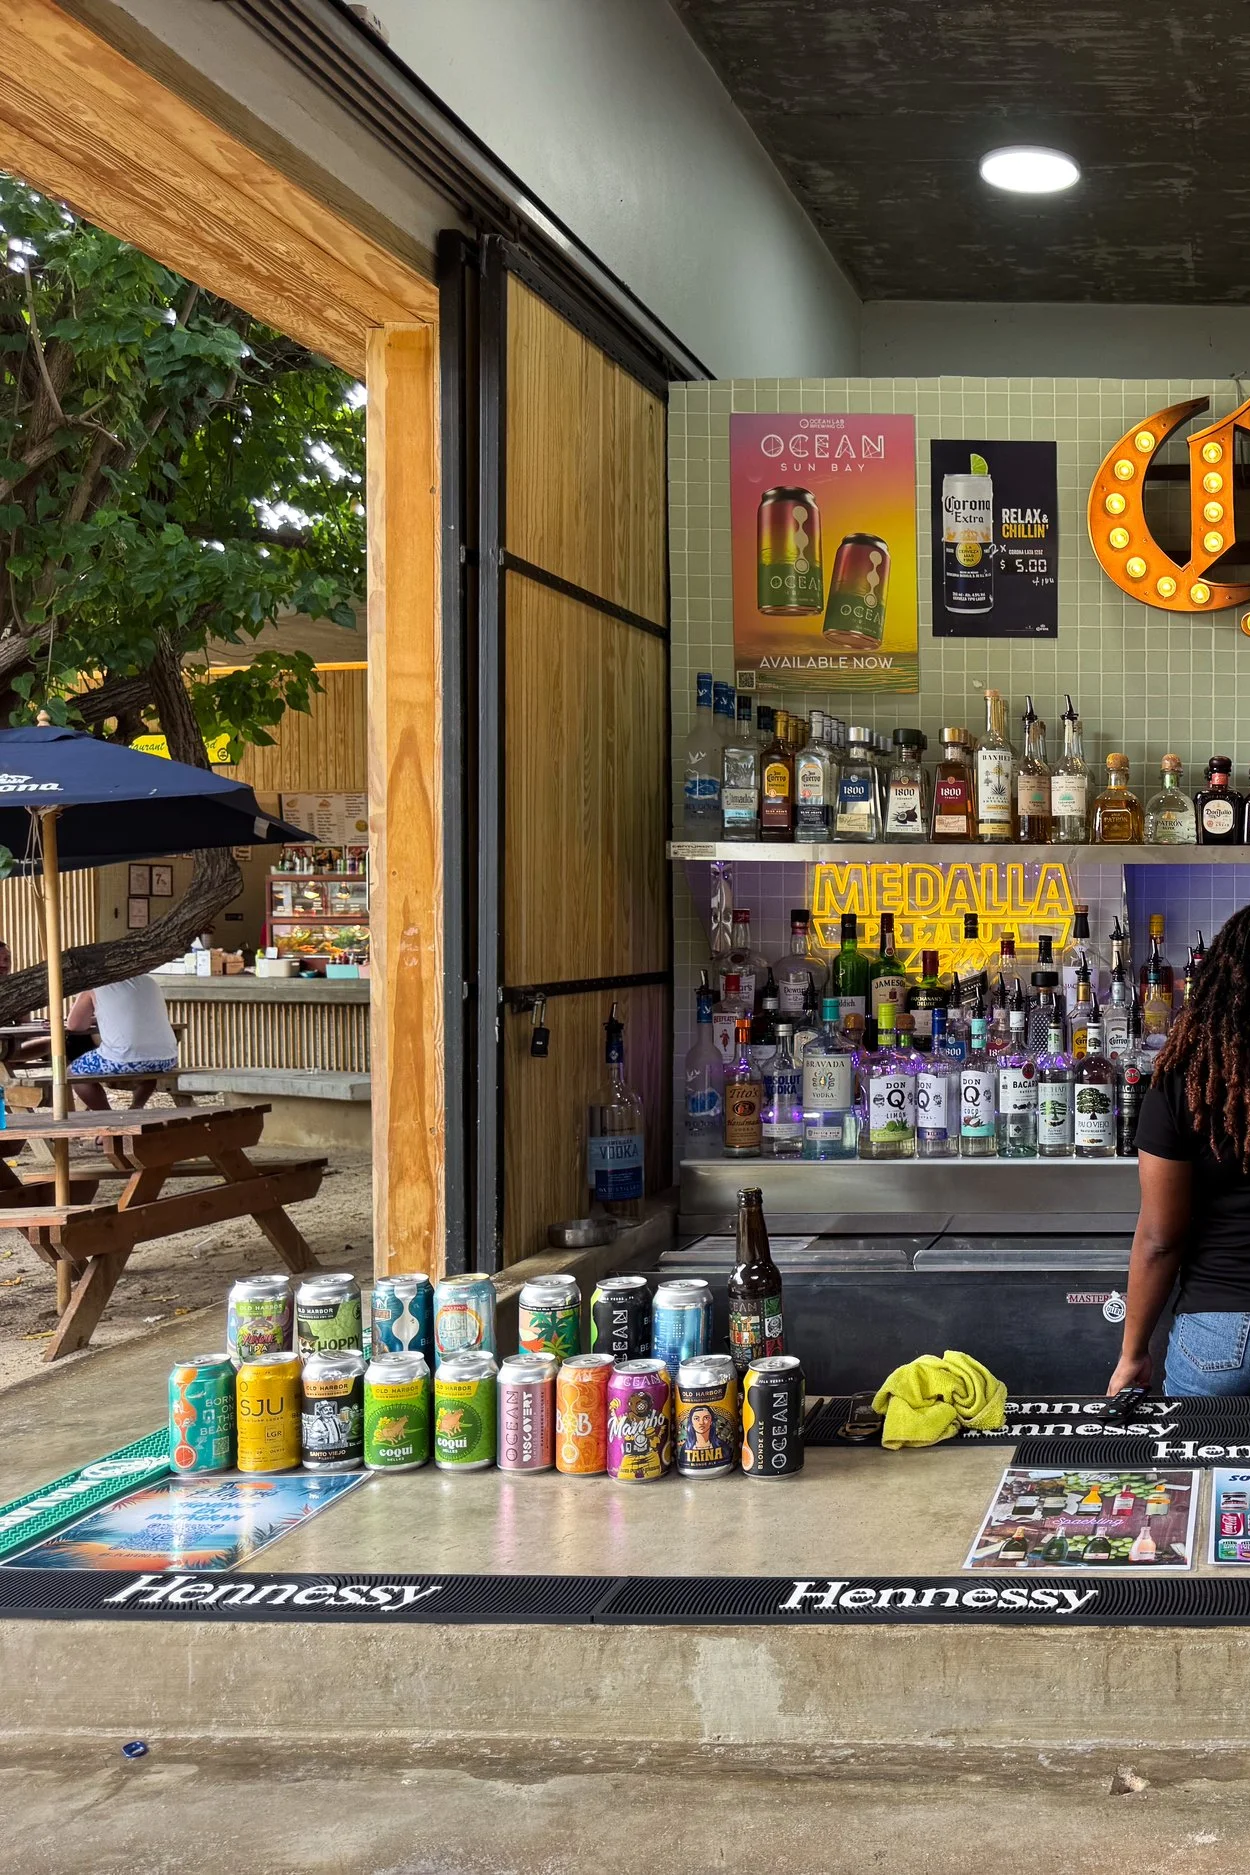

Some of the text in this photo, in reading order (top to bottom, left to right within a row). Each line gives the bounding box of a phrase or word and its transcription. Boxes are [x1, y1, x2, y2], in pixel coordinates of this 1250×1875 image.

[760, 434, 885, 459] OCEAN
[780, 462, 865, 473] SUN BAY
[944, 495, 991, 514] Corona
[951, 512, 984, 523] Extra
[1002, 524, 1049, 538] CHILLIN'
[1016, 559, 1047, 573] 5.00
[759, 656, 894, 669] AVAILABLE NOW
[843, 786, 864, 795] 1800
[895, 788, 915, 796] 1800
[940, 787, 962, 797] 1800
[812, 863, 1074, 916] MEDALLA
[806, 1060, 845, 1068] BRAVADA
[729, 1088, 759, 1099] Tito's
[886, 1089, 906, 1112] Q
[963, 1086, 981, 1107] Q
[600, 1144, 639, 1159] VODKA
[317, 1335, 359, 1351] HOPPY
[392, 1385, 419, 1393] HARBOR
[696, 1389, 723, 1397] HARBOR
[206, 1395, 233, 1406] BORN
[240, 1397, 284, 1416] SJU
[222, 1404, 233, 1413] ON
[217, 1414, 234, 1423] THE
[506, 1390, 519, 1461] OCEAN
[200, 1422, 234, 1436] BEACH
[522, 1391, 533, 1462] DISCOVERY
[771, 1391, 789, 1469] OCEAN
[145, 1514, 246, 1522] INSTAGRAM
[104, 1575, 443, 1612] Hennessy
[779, 1581, 1098, 1613] Hennessy
